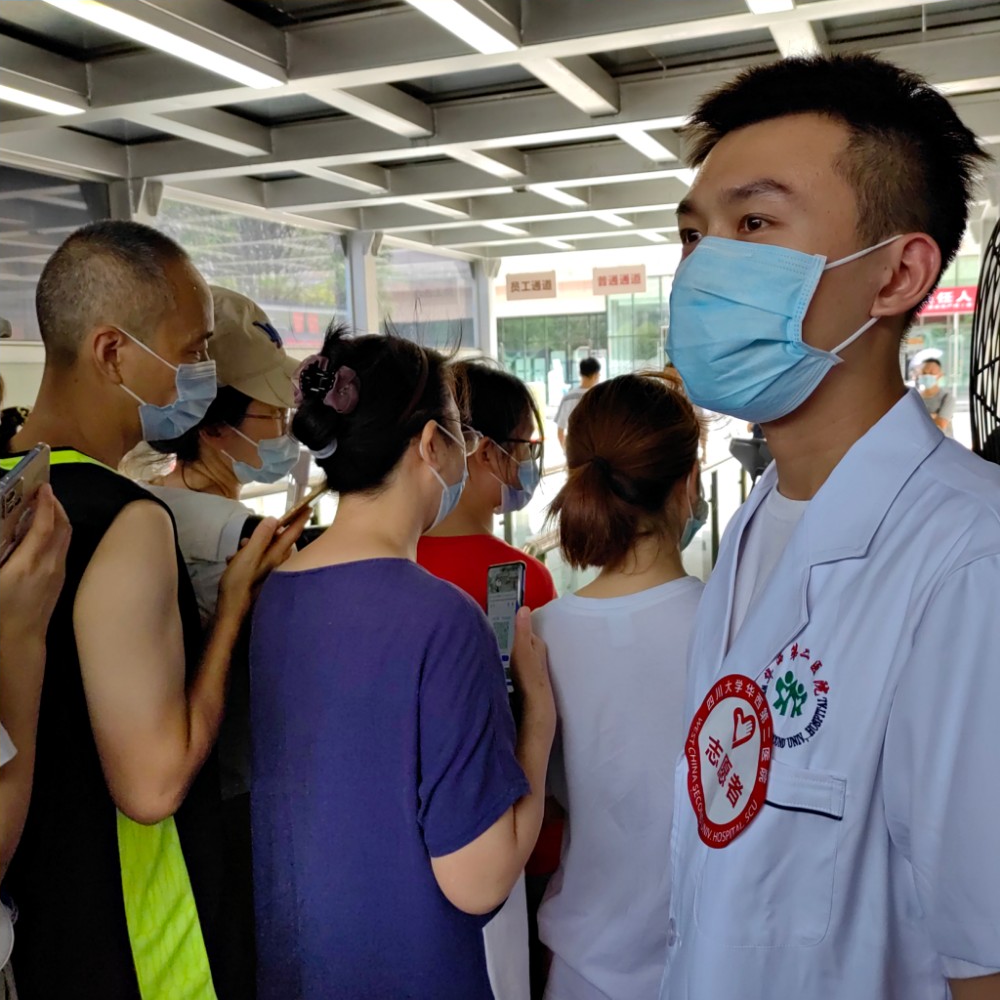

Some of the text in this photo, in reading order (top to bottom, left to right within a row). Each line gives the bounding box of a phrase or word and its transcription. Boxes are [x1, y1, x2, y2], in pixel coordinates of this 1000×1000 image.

[688, 747, 699, 783] CHINA
[713, 822, 745, 843] HOSPITAL
[744, 799, 758, 823] SCU
[705, 736, 744, 808] 志愿者
